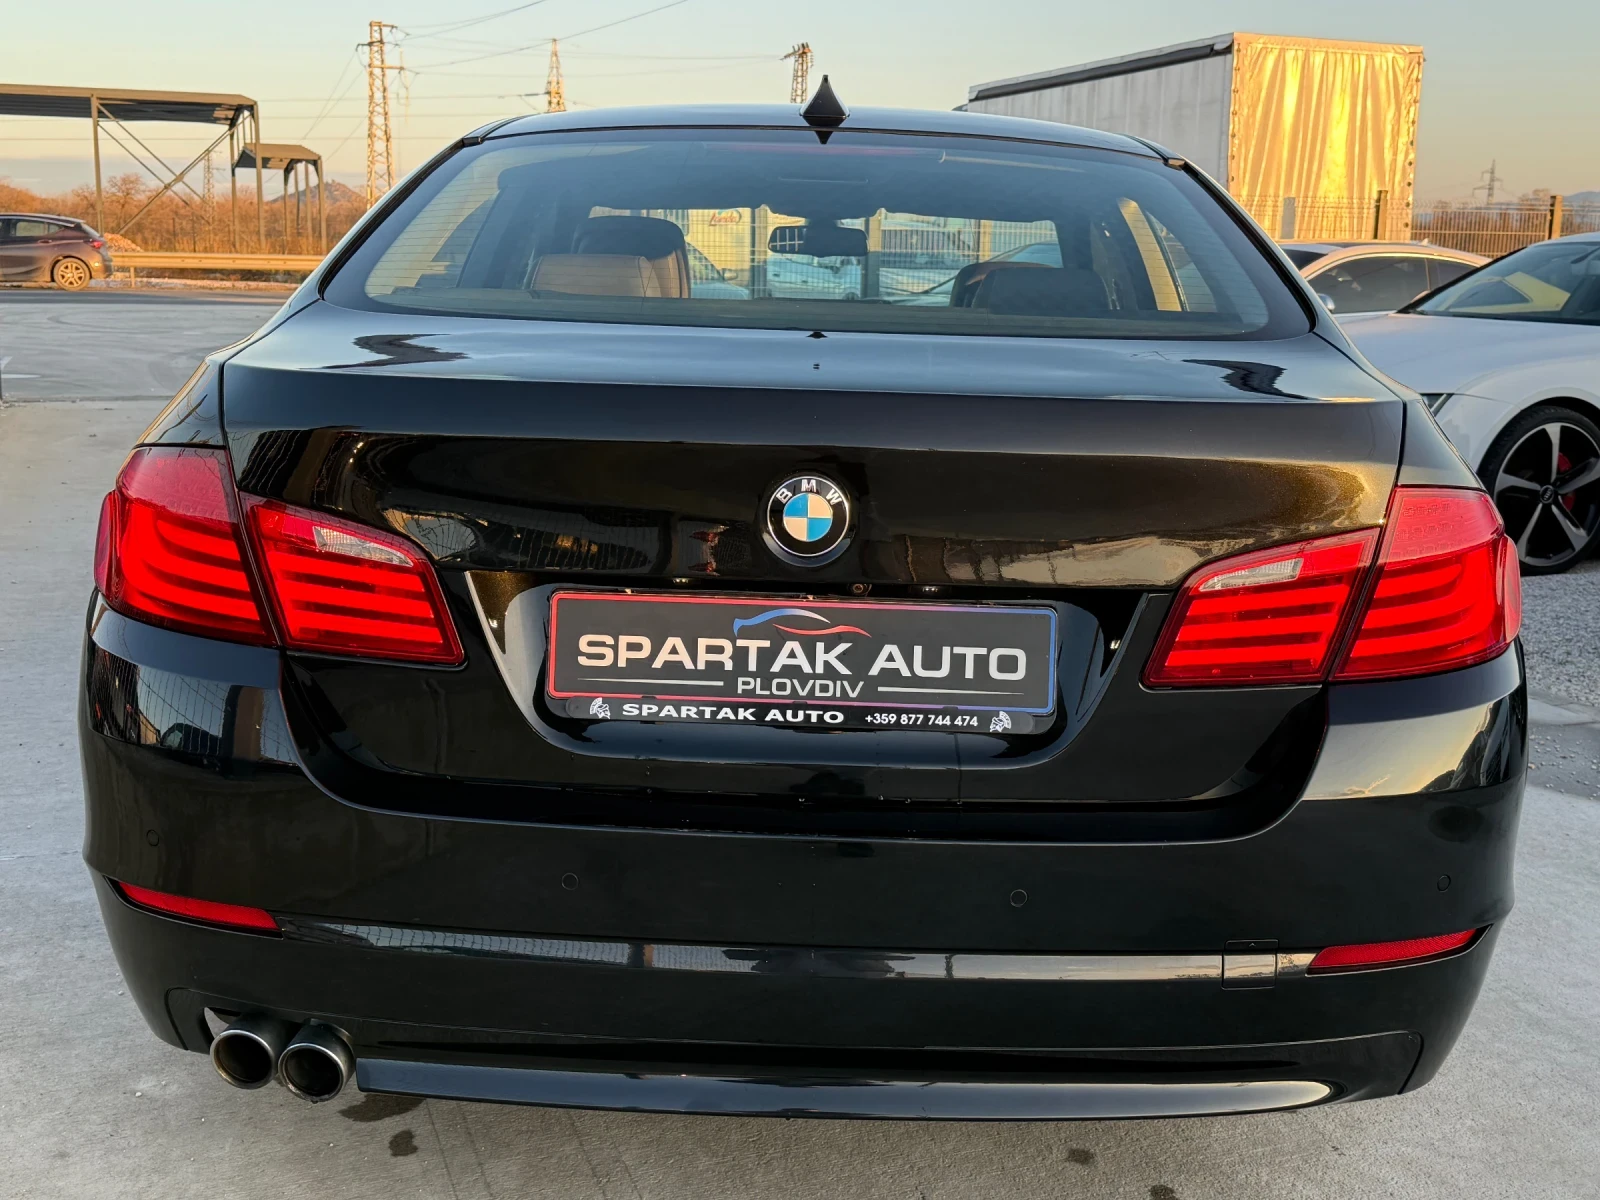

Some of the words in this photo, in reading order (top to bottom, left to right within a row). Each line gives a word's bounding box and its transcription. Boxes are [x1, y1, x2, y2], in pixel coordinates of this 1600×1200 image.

[776, 479, 842, 505] BMW
[577, 634, 853, 675] SPARTAK
[868, 644, 1027, 680] AUTO
[737, 677, 865, 698] PLOVDIV
[622, 704, 757, 721] SPARTAK
[764, 709, 845, 724] AUTO
[865, 713, 897, 725] +359
[899, 714, 924, 726] 877
[927, 715, 951, 727] 744
[953, 716, 979, 727] 474
